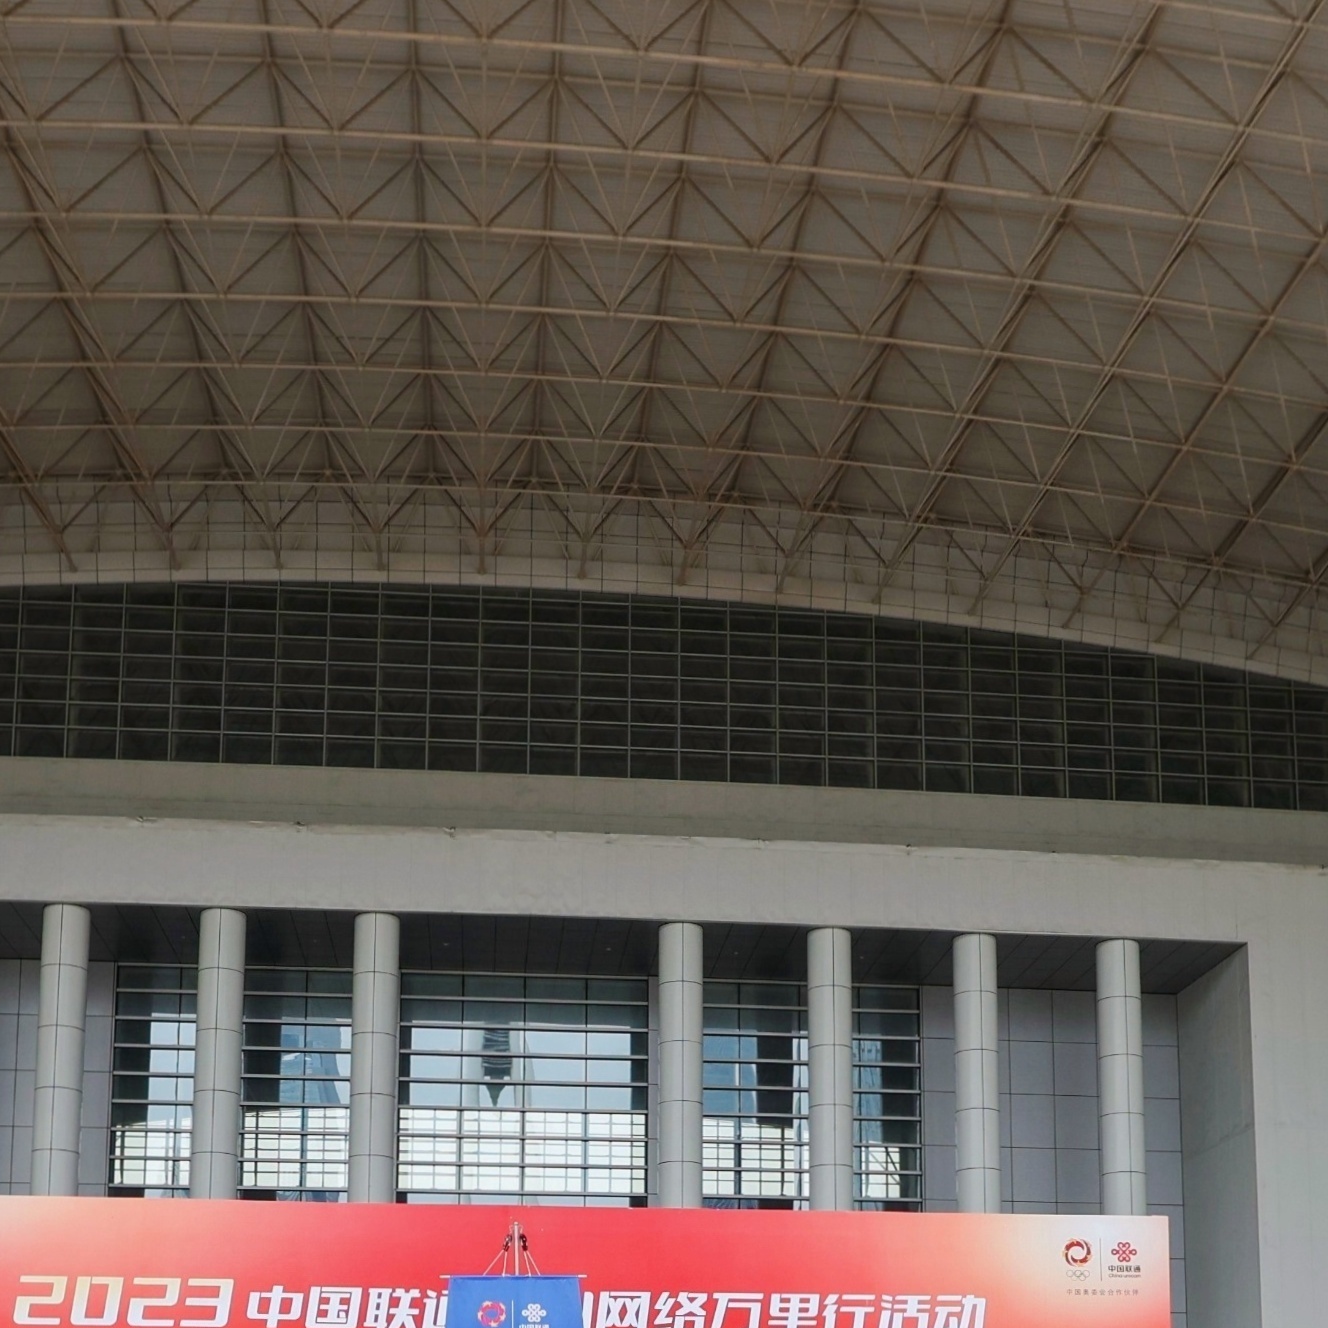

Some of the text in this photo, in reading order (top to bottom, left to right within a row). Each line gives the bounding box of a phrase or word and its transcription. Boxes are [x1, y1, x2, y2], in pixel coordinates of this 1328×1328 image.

[1108, 1265, 1141, 1273] 中国联通
[1066, 1288, 1140, 1296] 中国奥委会合作伙伴
[13, 1275, 234, 1328] 2023
